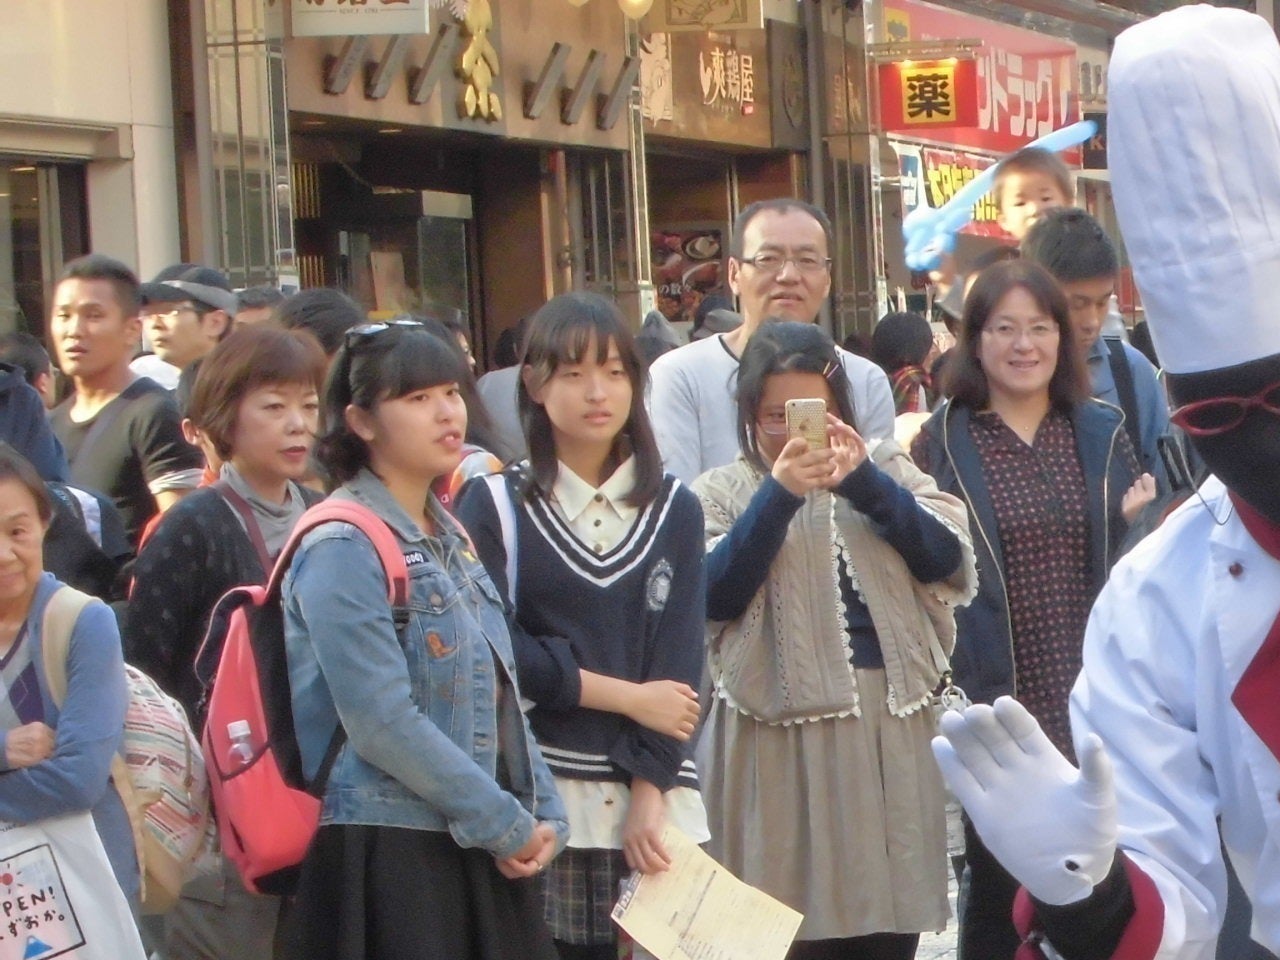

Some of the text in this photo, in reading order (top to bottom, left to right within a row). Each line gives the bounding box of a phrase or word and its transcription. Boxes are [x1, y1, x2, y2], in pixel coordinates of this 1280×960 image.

[907, 72, 951, 118] 薬
[0, 910, 65, 940] ずおか。
